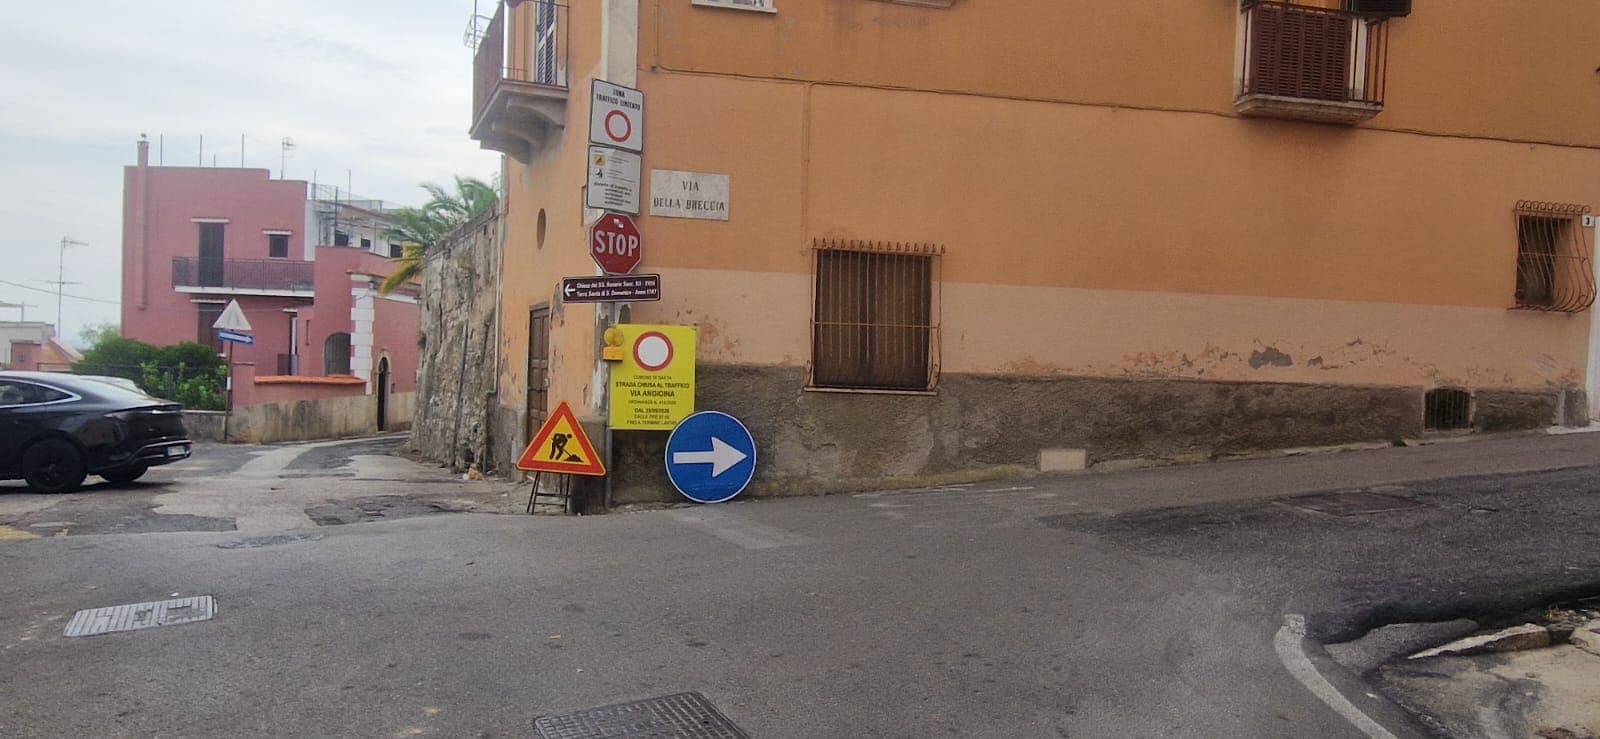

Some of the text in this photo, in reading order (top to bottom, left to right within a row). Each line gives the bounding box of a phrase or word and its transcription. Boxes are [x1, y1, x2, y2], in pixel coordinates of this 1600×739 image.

[613, 89, 625, 98] ZONA
[597, 94, 640, 111] TRAFFICO LIMITATO
[682, 180, 699, 192] VIA
[654, 197, 725, 212] DELLA BRECCIA
[595, 230, 639, 257] STOP
